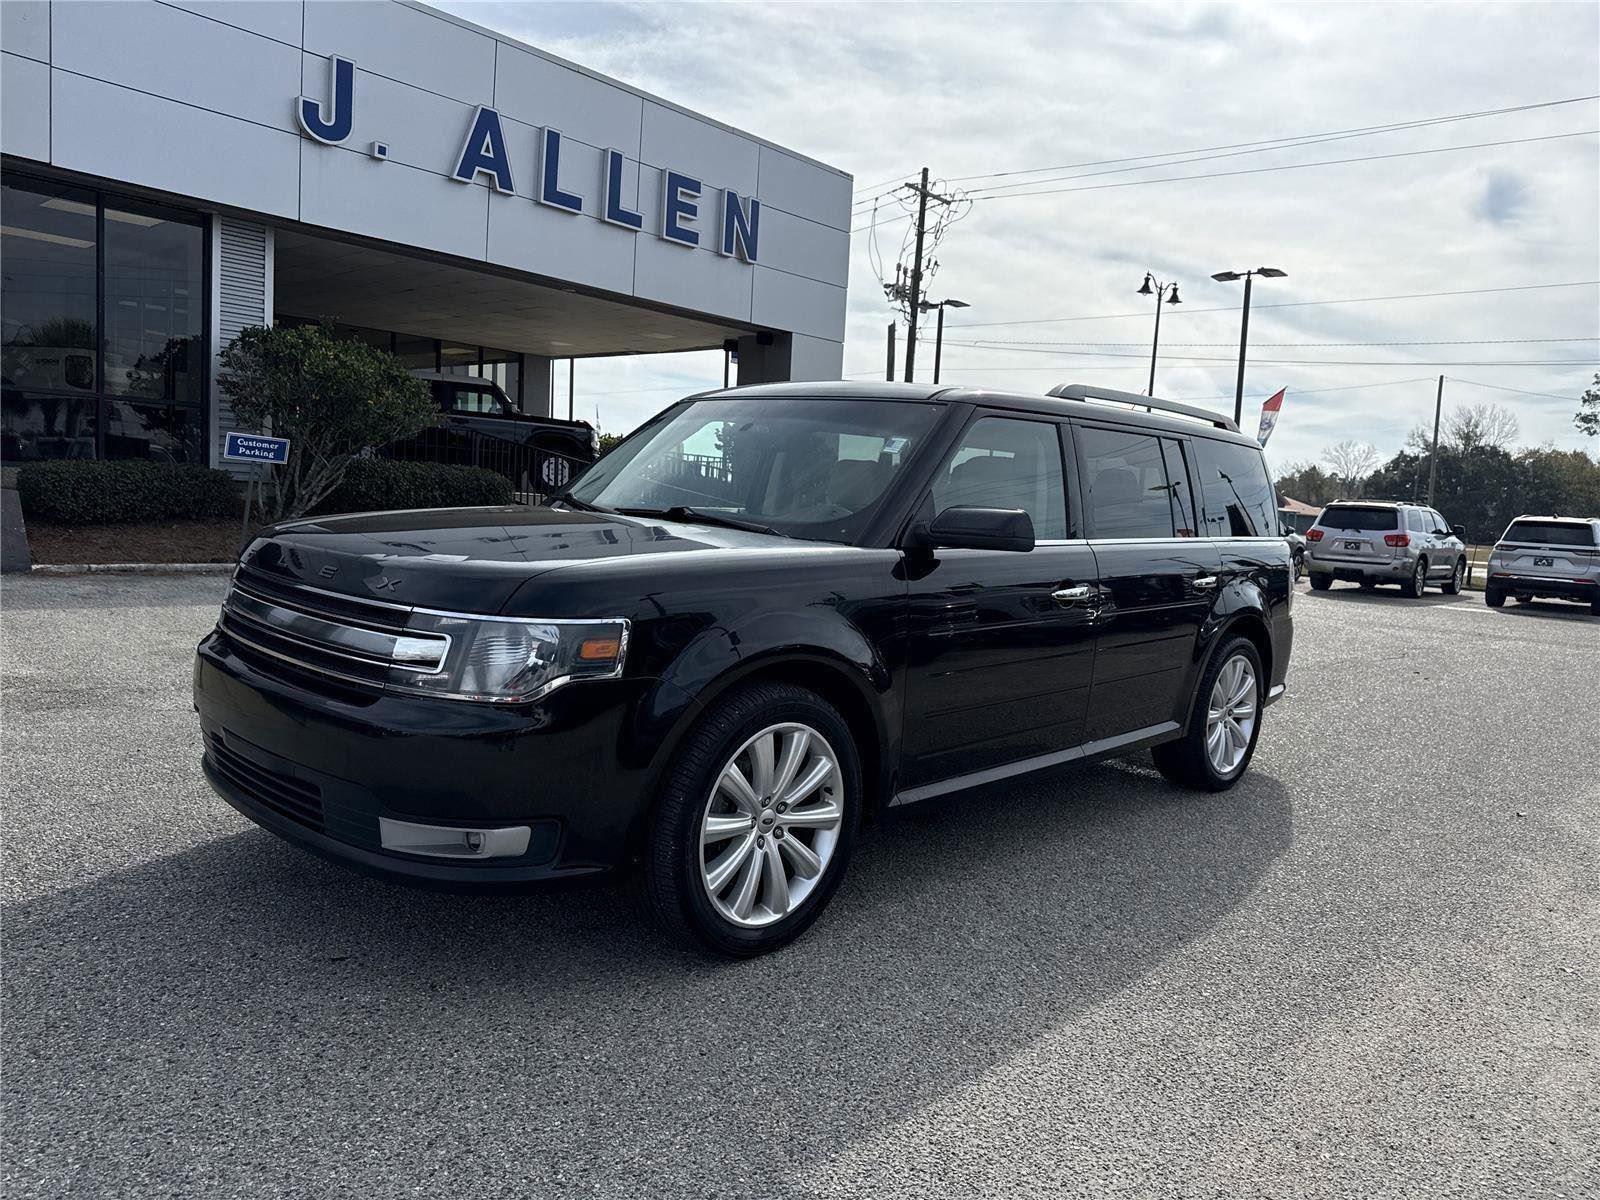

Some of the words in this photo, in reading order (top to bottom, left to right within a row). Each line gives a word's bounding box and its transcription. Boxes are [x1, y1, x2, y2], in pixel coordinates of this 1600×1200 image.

[296, 54, 389, 160] J.
[450, 103, 761, 264] ALLEN
[237, 438, 279, 450] Customer
[238, 447, 275, 459] Parking
